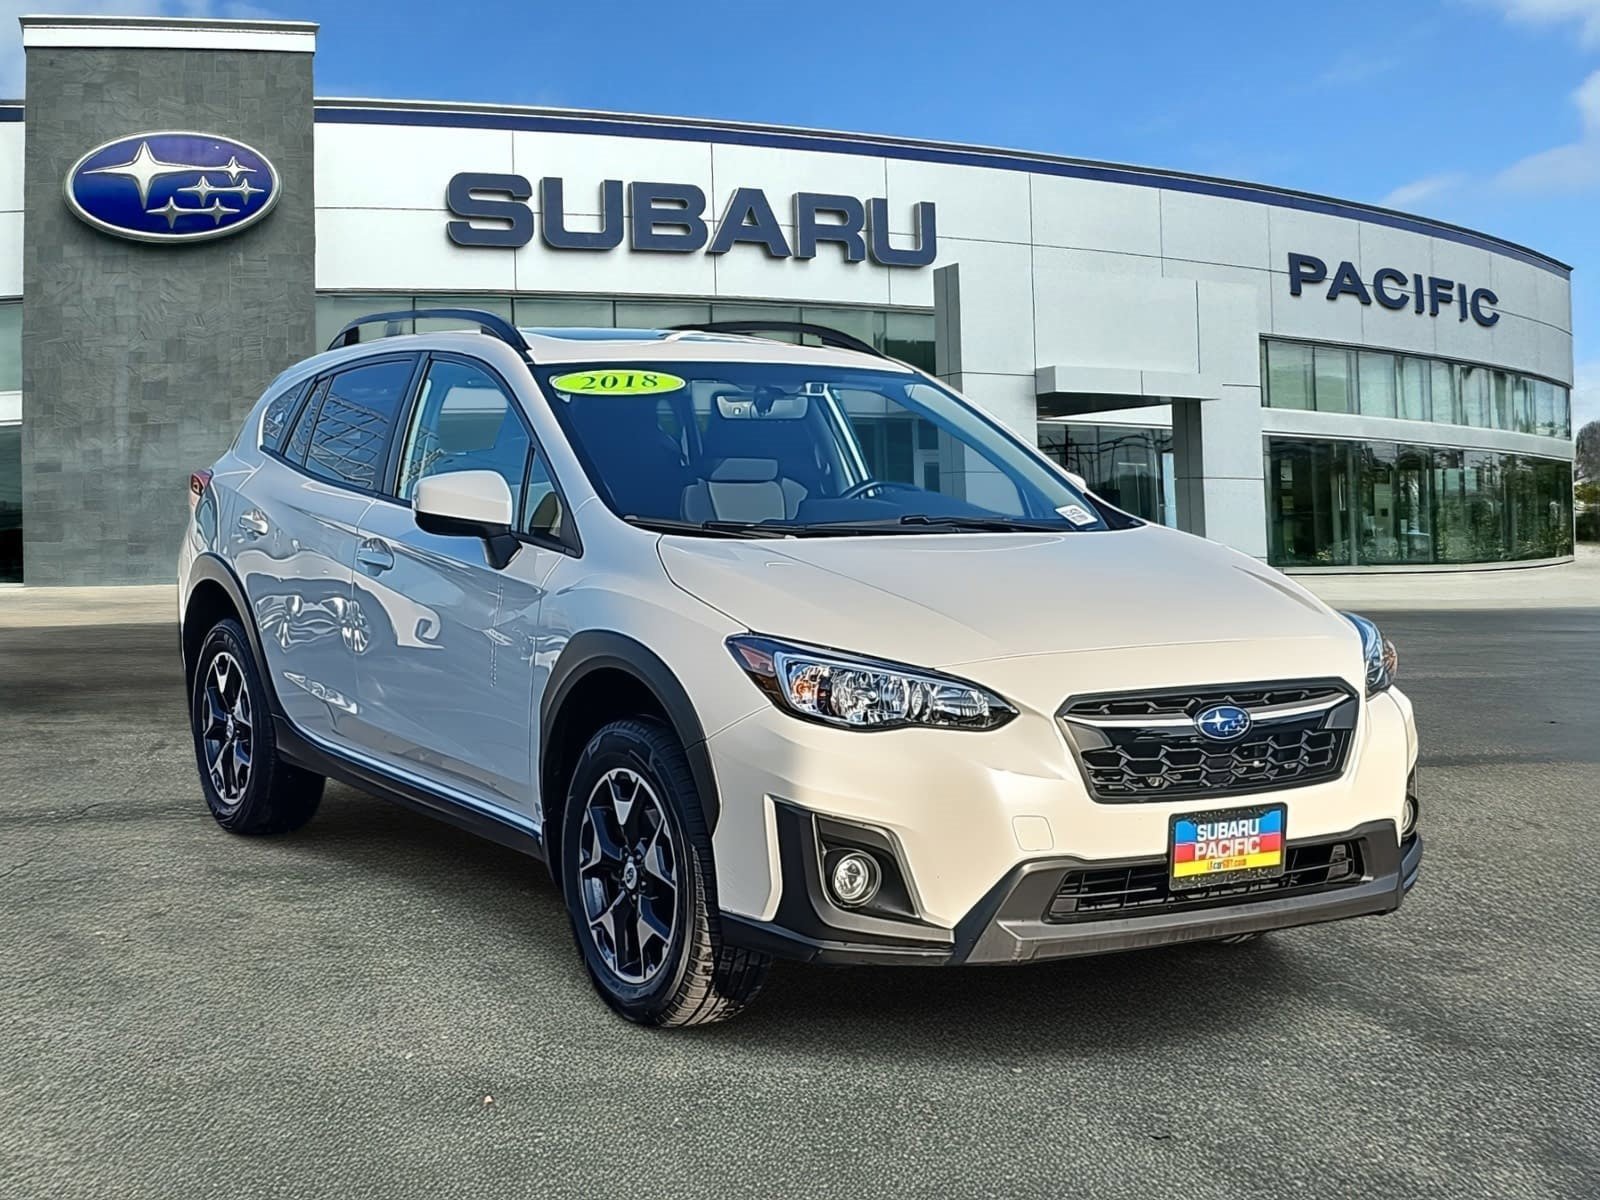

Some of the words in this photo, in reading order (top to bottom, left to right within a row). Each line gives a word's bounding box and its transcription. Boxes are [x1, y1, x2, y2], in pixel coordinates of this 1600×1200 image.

[447, 172, 937, 267] SUBARU
[1288, 252, 1500, 327] PACIFIC
[580, 375, 658, 390] 2018
[1196, 818, 1260, 842] SUBARU
[1194, 836, 1261, 861] PACIFIC
